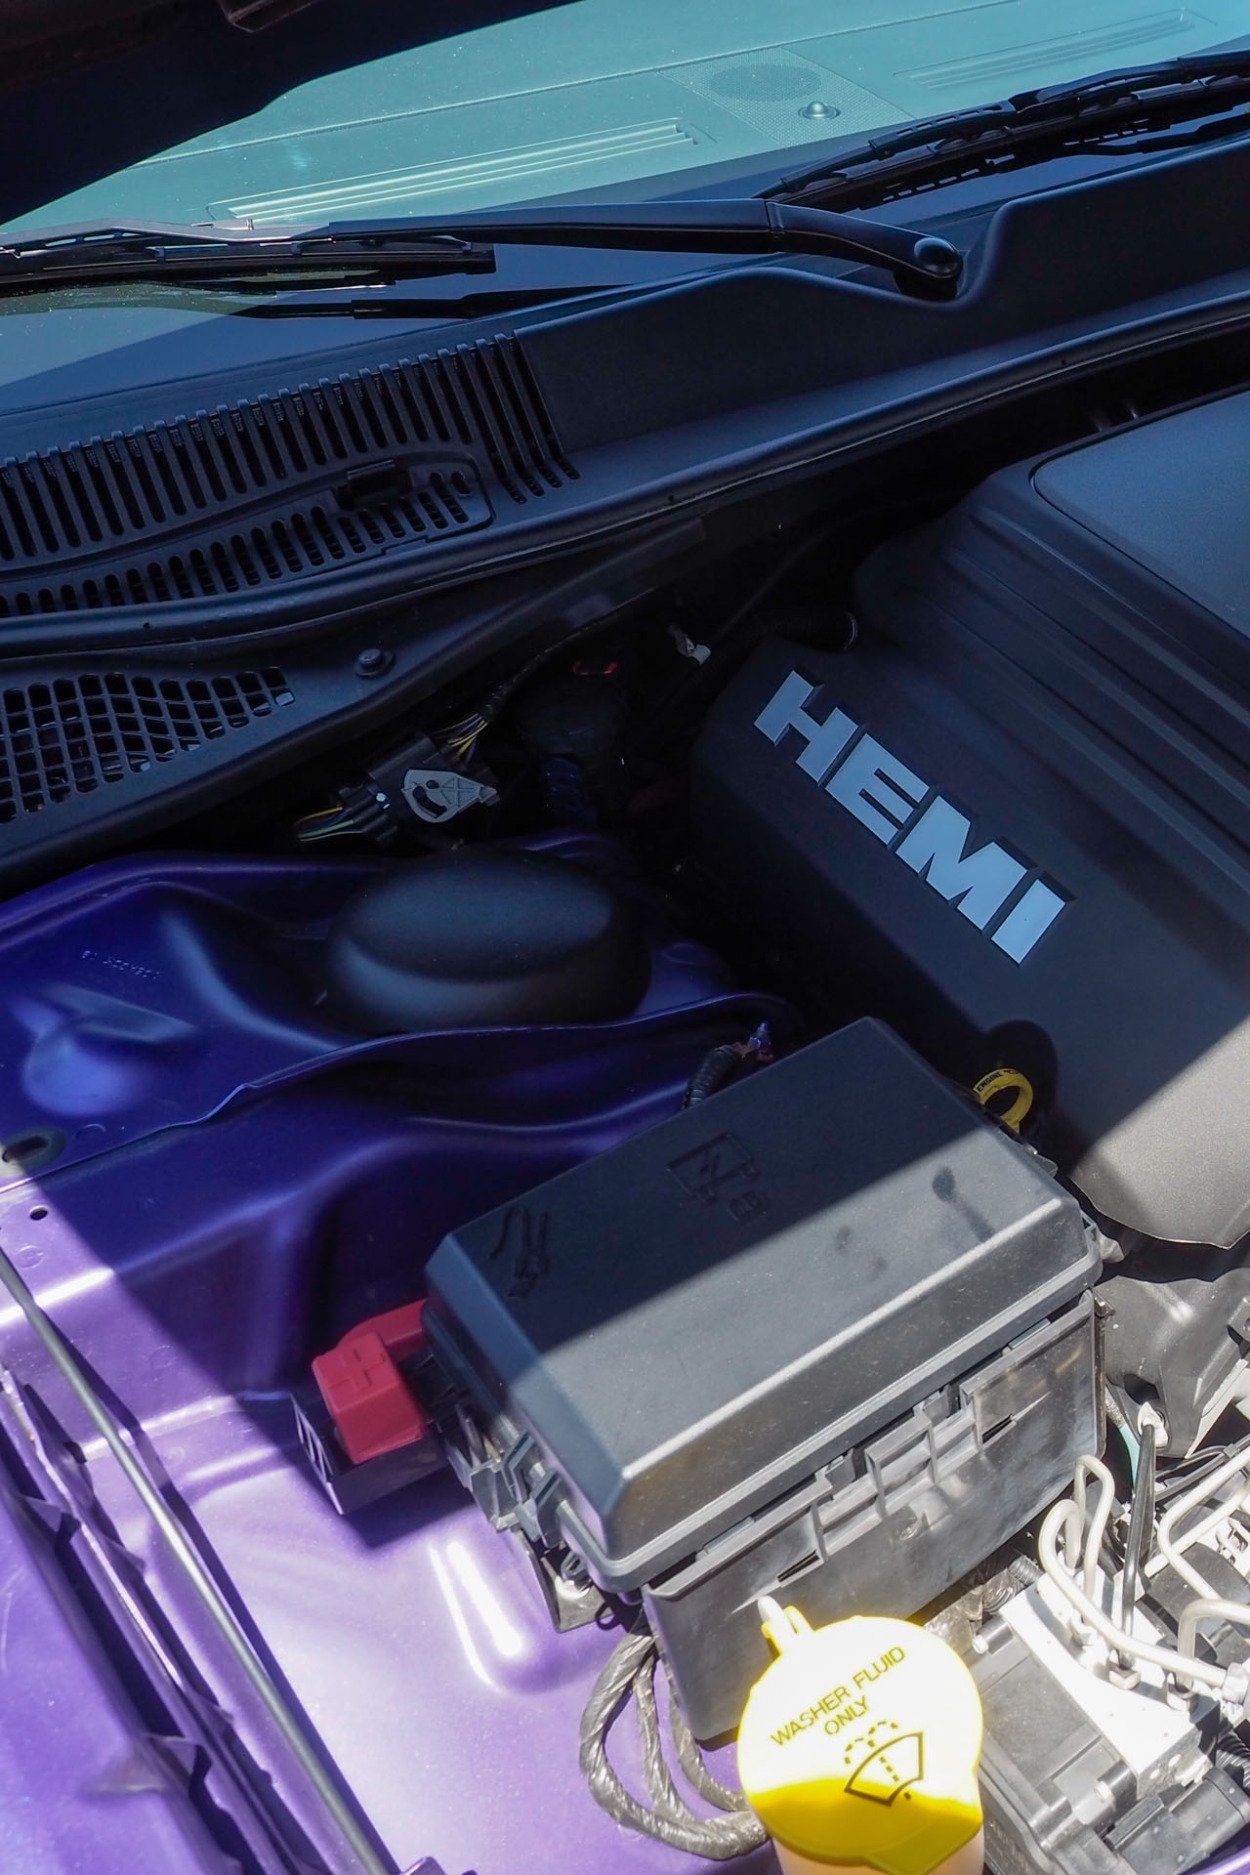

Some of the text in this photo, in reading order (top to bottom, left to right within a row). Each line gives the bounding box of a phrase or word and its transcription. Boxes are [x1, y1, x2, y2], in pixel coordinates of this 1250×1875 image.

[753, 669, 1068, 966] HEMI
[770, 1645, 906, 1747] WASHER FLUID
[823, 1695, 868, 1737] ONLY
